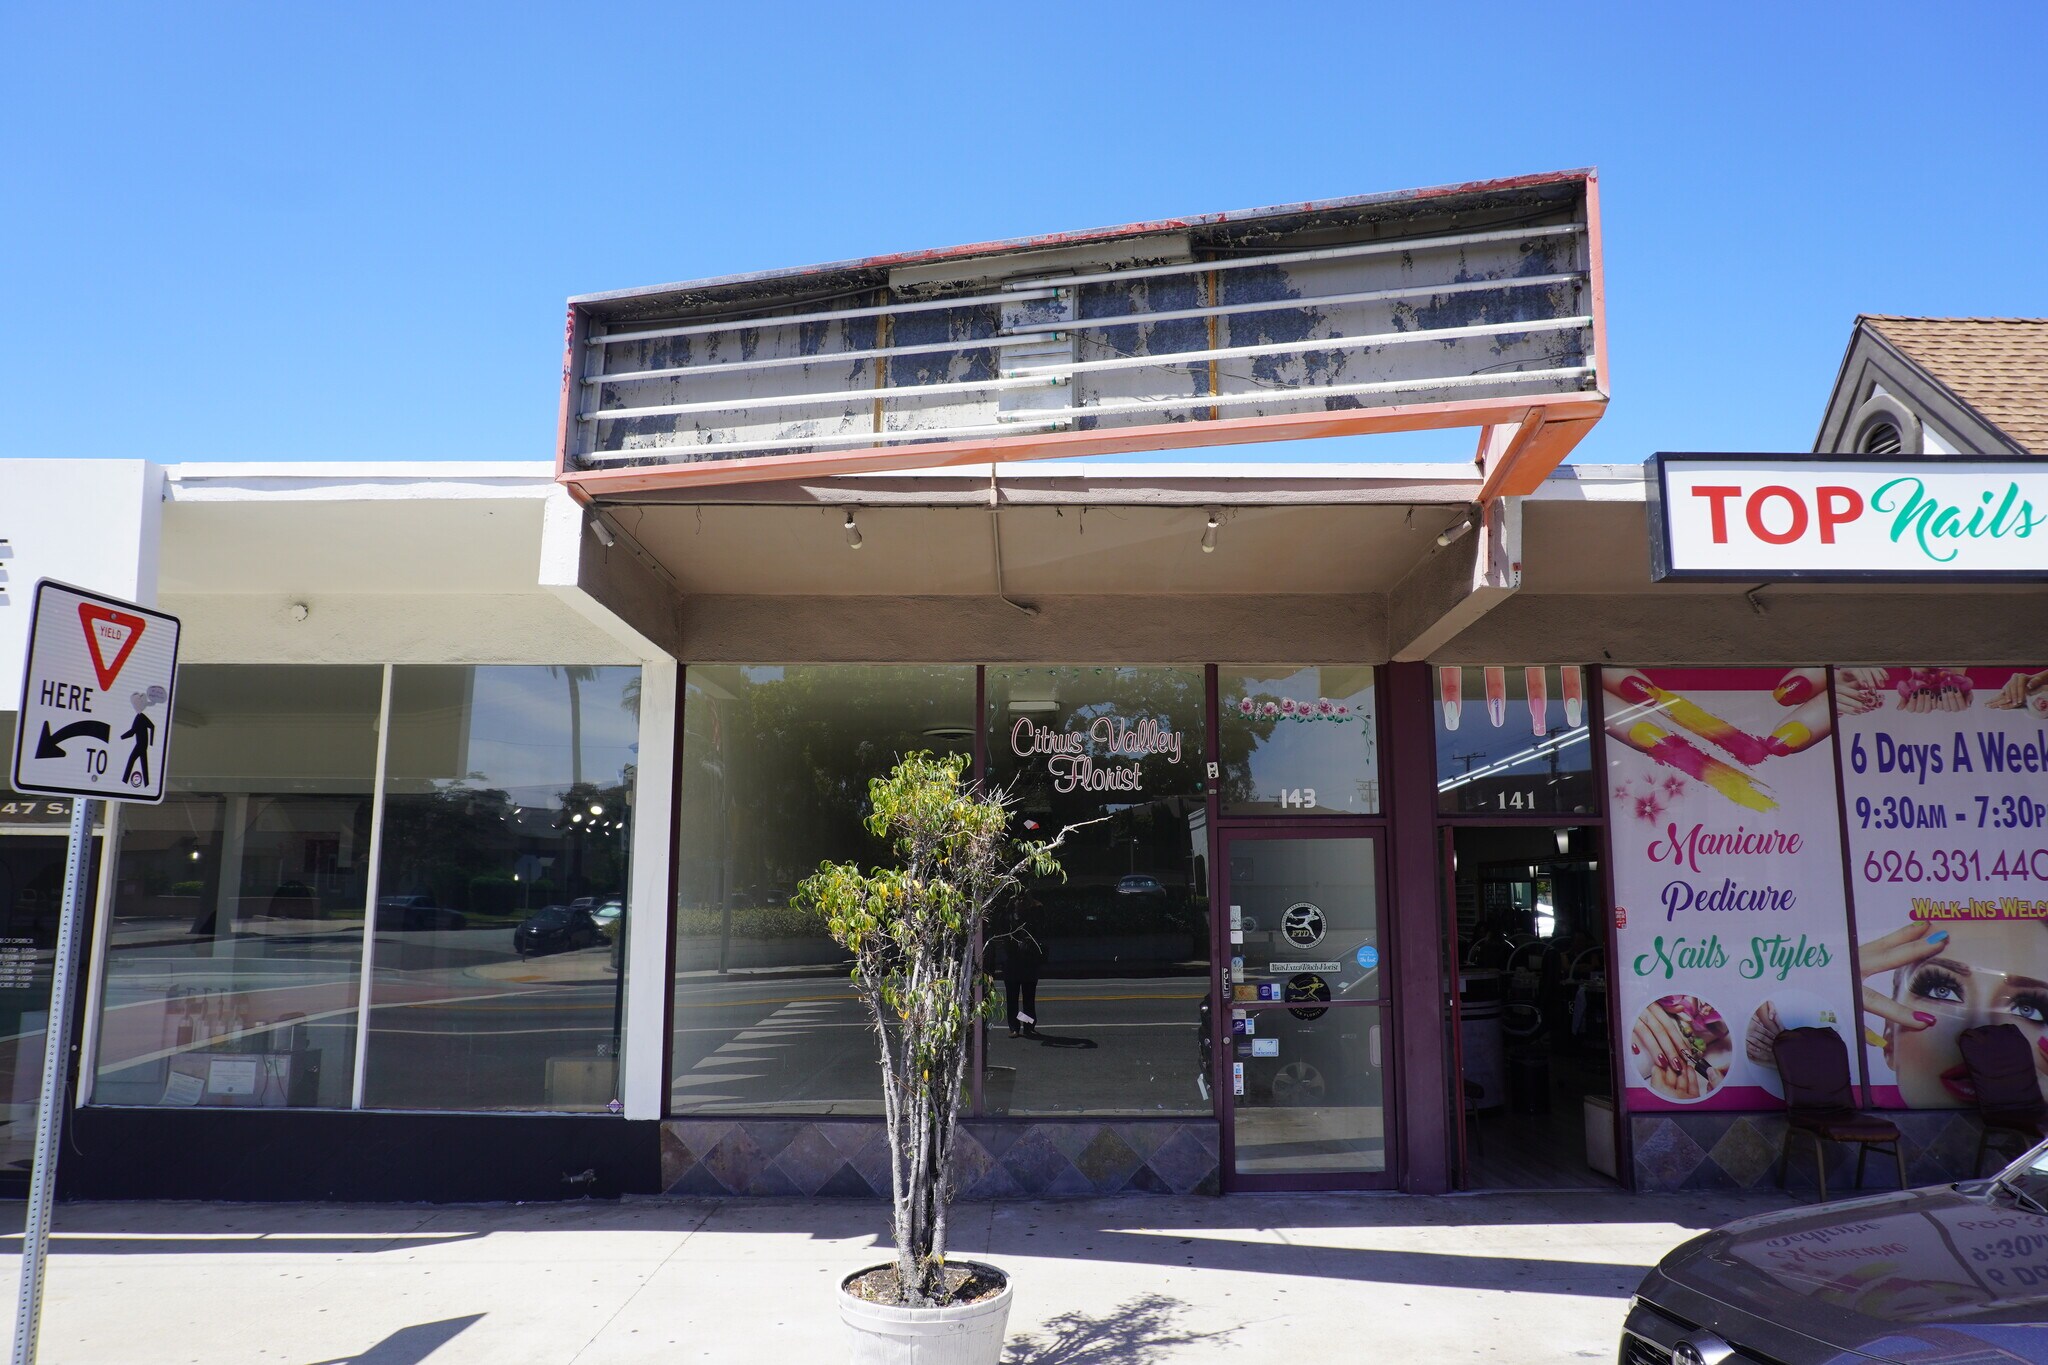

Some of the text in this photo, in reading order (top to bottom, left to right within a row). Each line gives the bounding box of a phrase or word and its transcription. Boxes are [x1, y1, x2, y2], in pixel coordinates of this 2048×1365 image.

[1691, 477, 2047, 562] TOP Nails
[100, 625, 122, 641] YIELD
[40, 679, 94, 713] HERE
[1011, 716, 1182, 764] Citrus Valley
[1851, 729, 2048, 785] 6 Days A Week
[86, 748, 108, 775] TO
[1048, 753, 1143, 793] Florist
[46, 802, 71, 815] S.
[1281, 788, 1316, 809] 143
[1497, 790, 1536, 810] 141
[1855, 796, 1948, 829] 9:30AM
[1974, 795, 2048, 829] 7:30P
[1647, 822, 1804, 873] Manicure
[1661, 878, 1797, 922] Pedicure
[1911, 897, 2048, 919] WALK-INS WELC
[1633, 933, 1833, 981] Nails Styles
